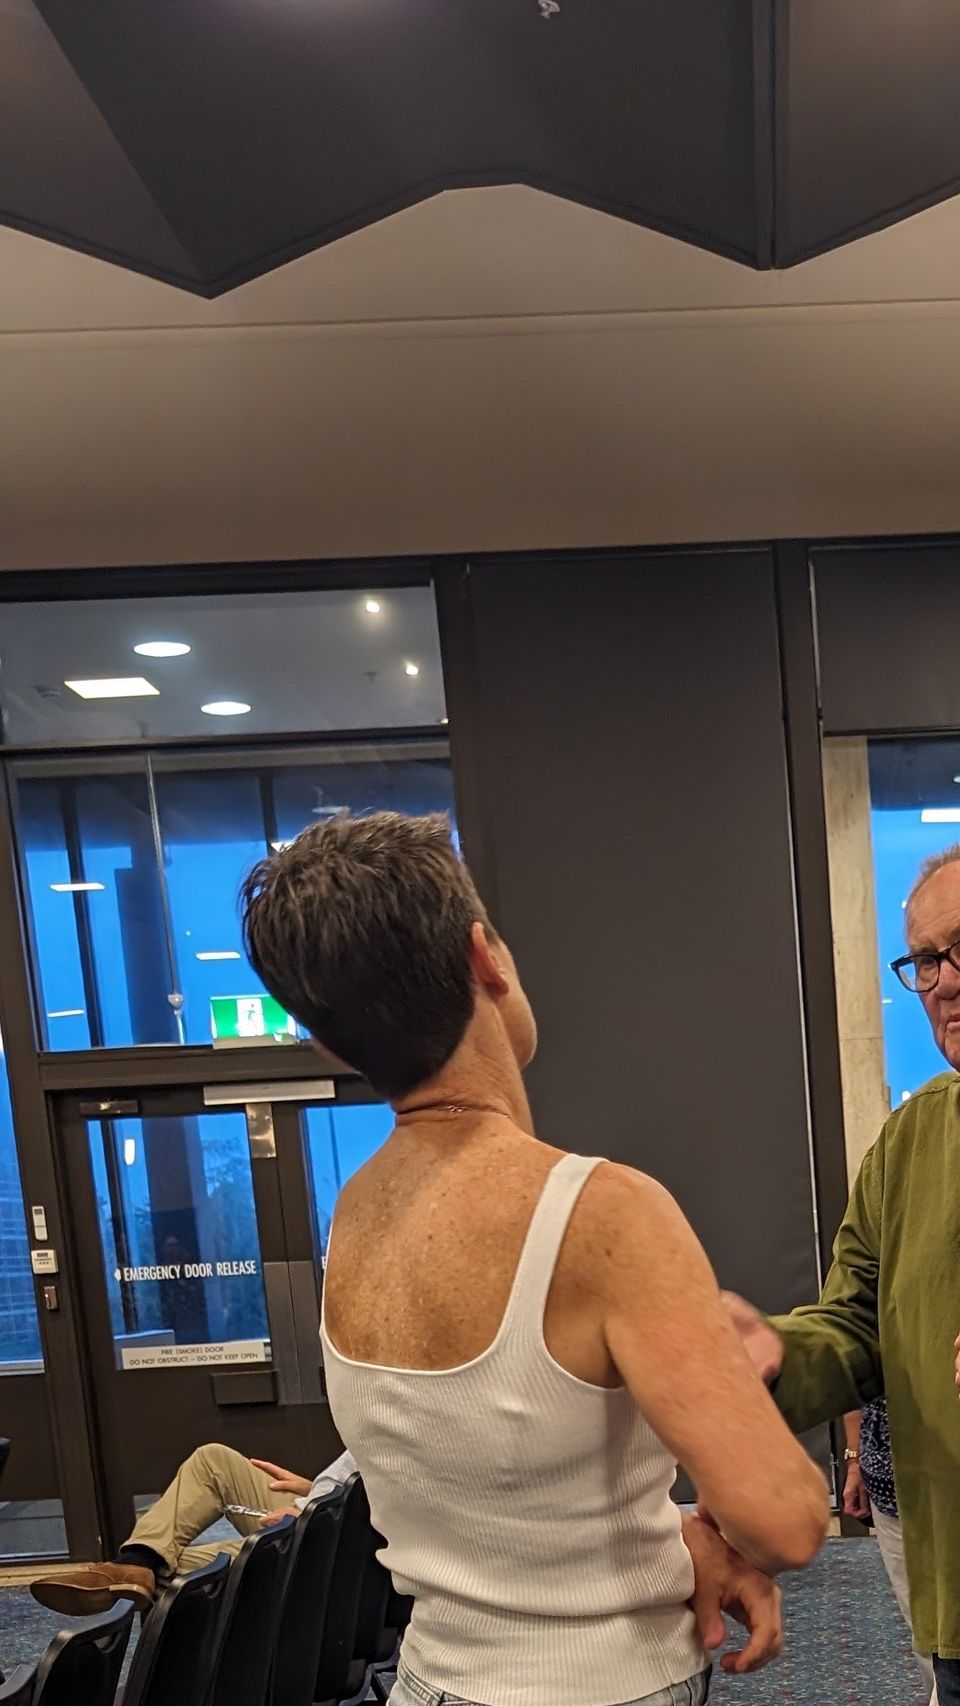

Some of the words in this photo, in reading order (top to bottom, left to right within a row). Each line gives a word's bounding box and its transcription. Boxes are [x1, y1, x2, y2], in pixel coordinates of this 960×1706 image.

[123, 1265, 181, 1281] EMERGENCY
[184, 1263, 213, 1278] DOOR
[216, 1260, 257, 1276] RELEASE
[157, 1356, 188, 1364] OBSTRUCT
[240, 1352, 258, 1360] OPEN
